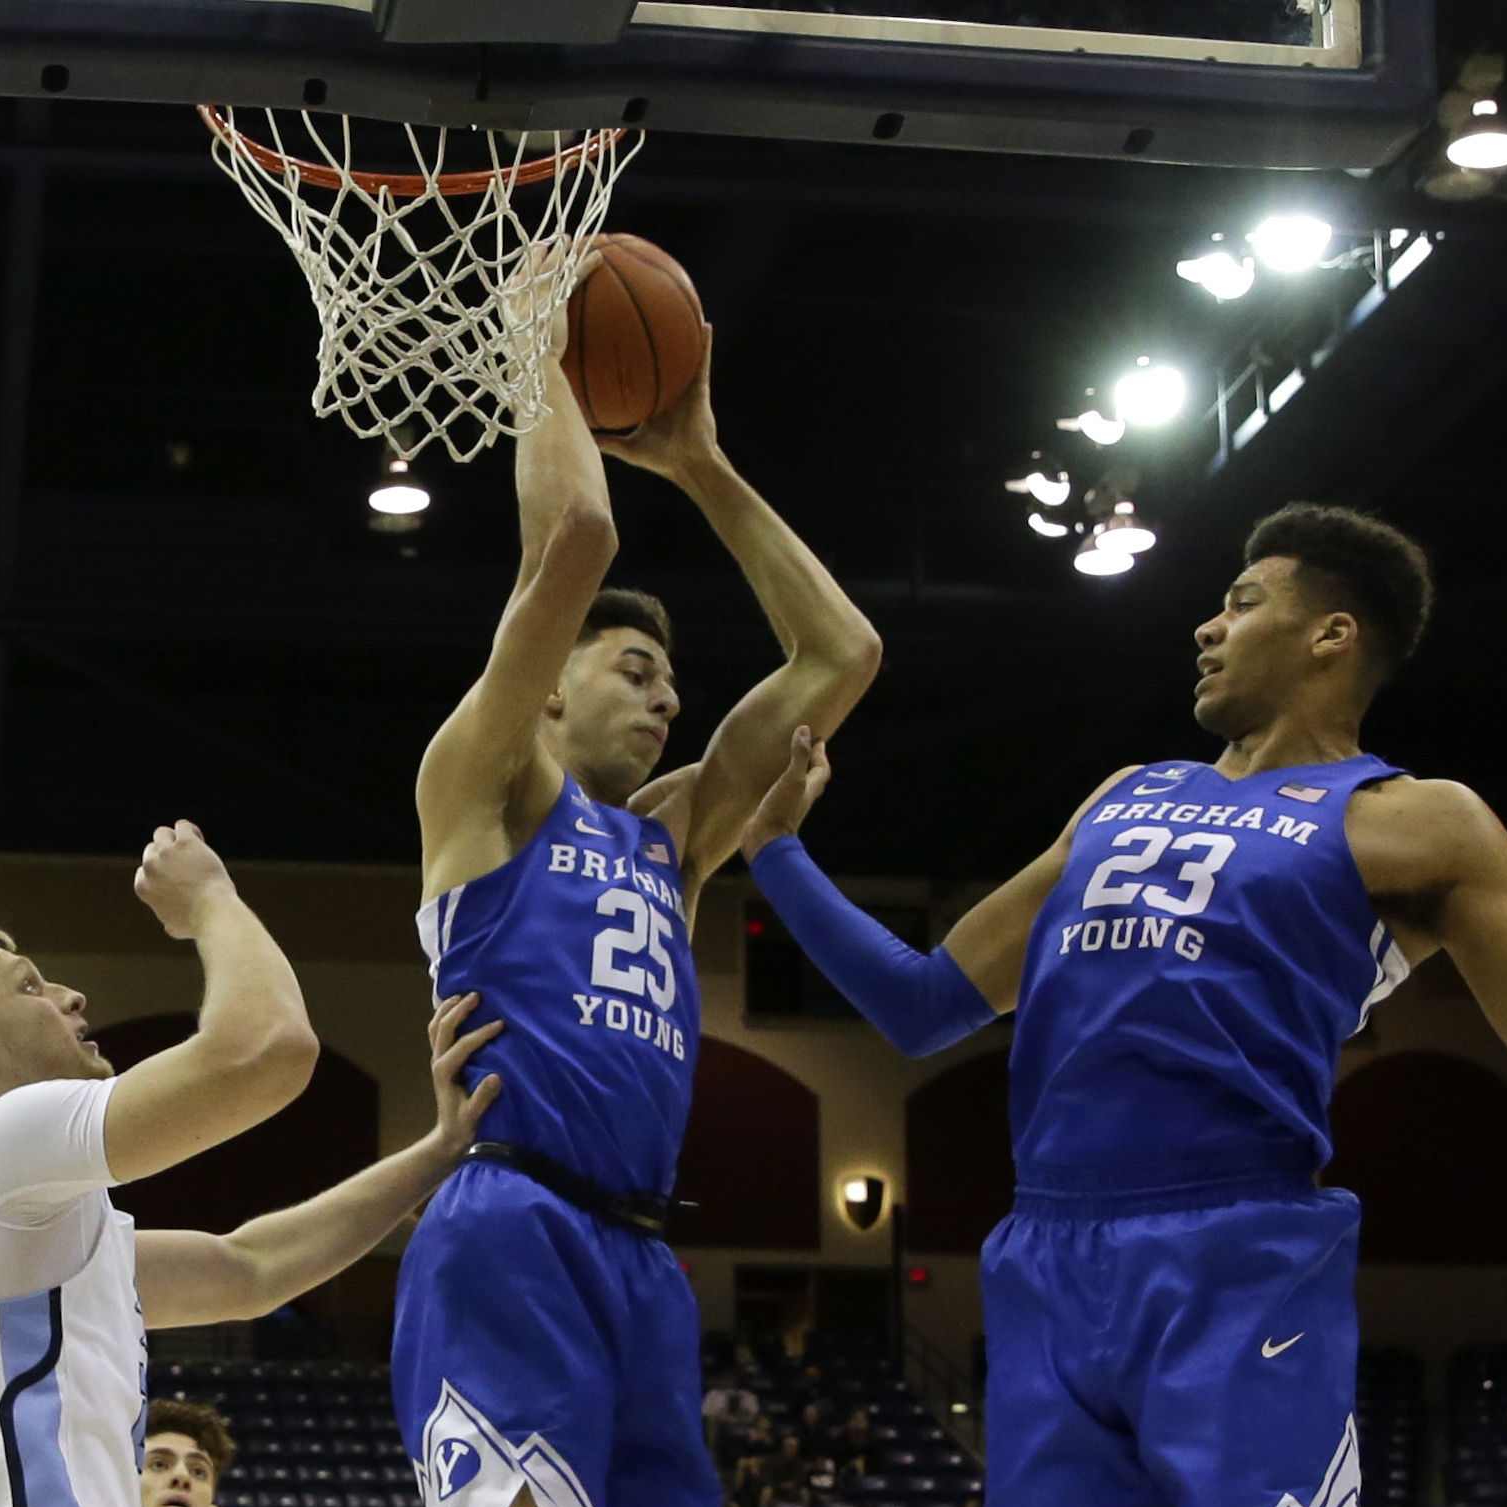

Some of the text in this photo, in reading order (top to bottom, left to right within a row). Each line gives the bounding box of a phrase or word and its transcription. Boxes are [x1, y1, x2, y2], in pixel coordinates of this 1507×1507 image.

[1092, 801, 1320, 846] BRIGHAM
[1082, 826, 1237, 916] 23
[590, 887, 677, 1013] 25
[1059, 916, 1206, 961] YOUNG
[572, 993, 685, 1061] YOUNG
